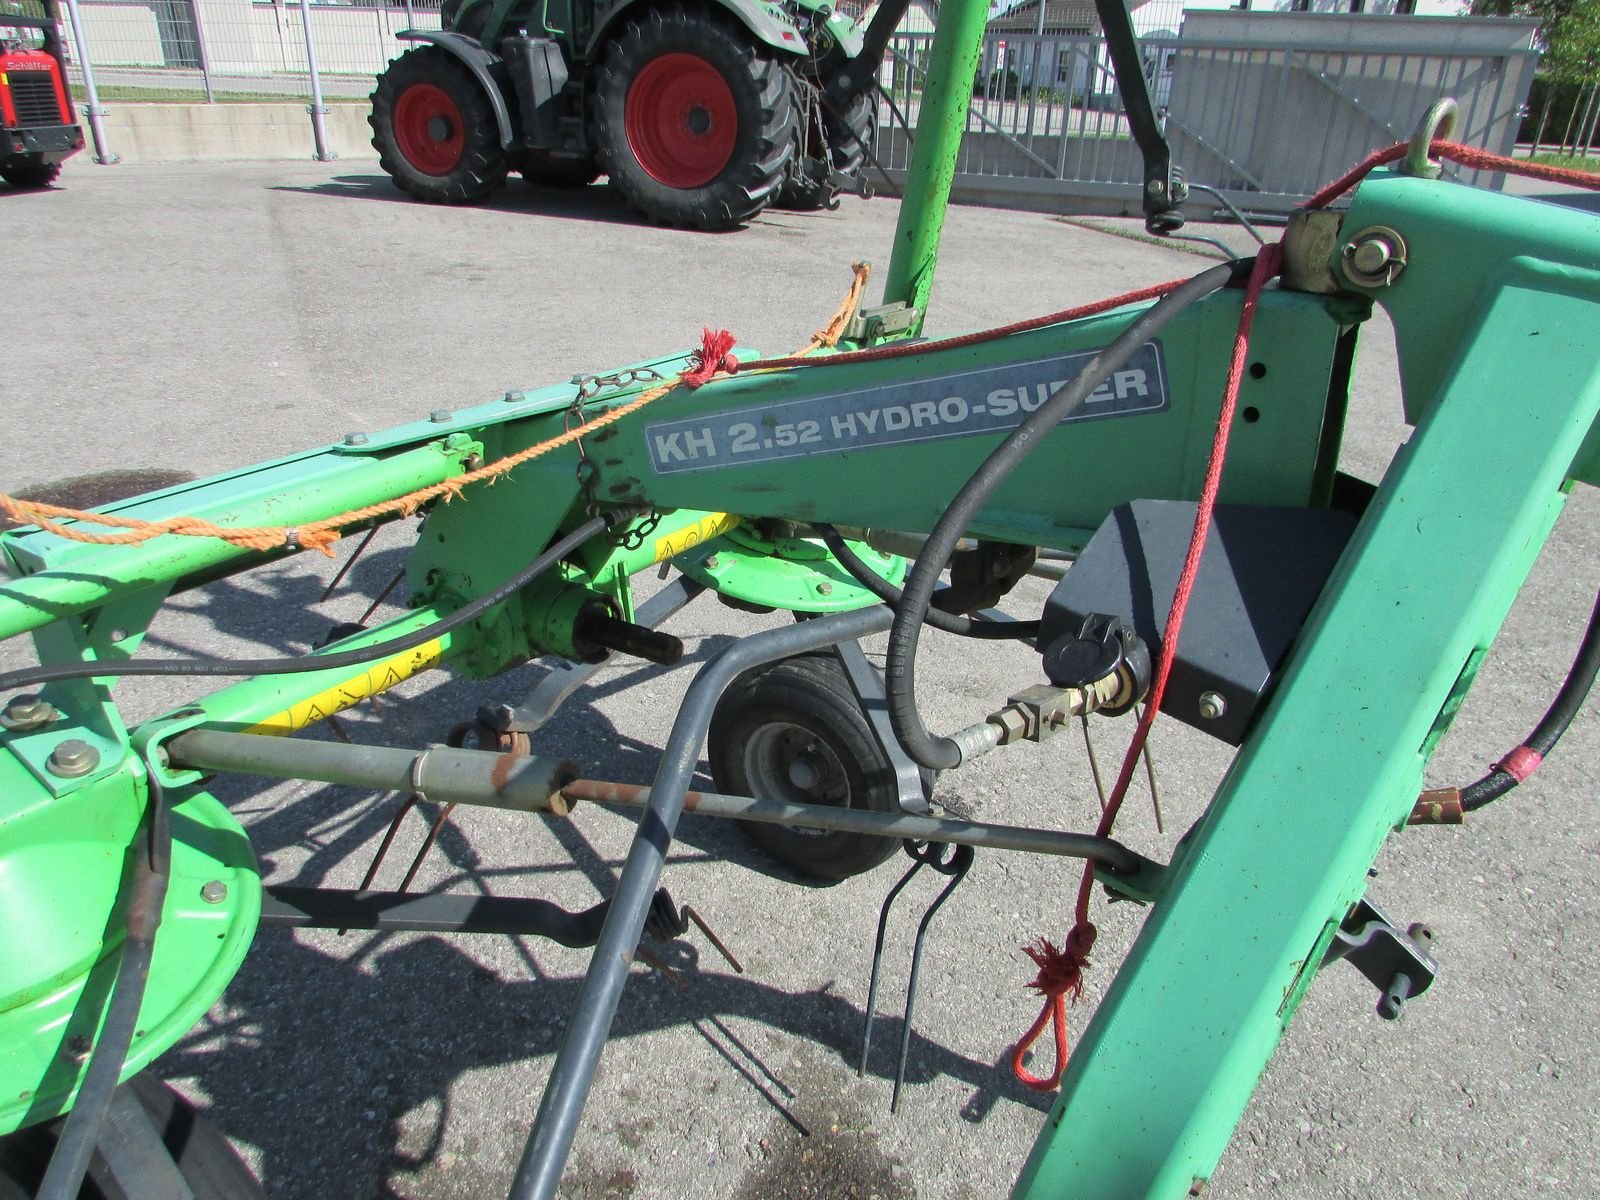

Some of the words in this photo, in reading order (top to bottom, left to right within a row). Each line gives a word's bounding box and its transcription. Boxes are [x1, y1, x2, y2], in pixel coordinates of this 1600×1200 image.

[654, 431, 718, 463] KH
[729, 420, 821, 455] 2.52
[832, 369, 1149, 440] HYDRO-SUER
